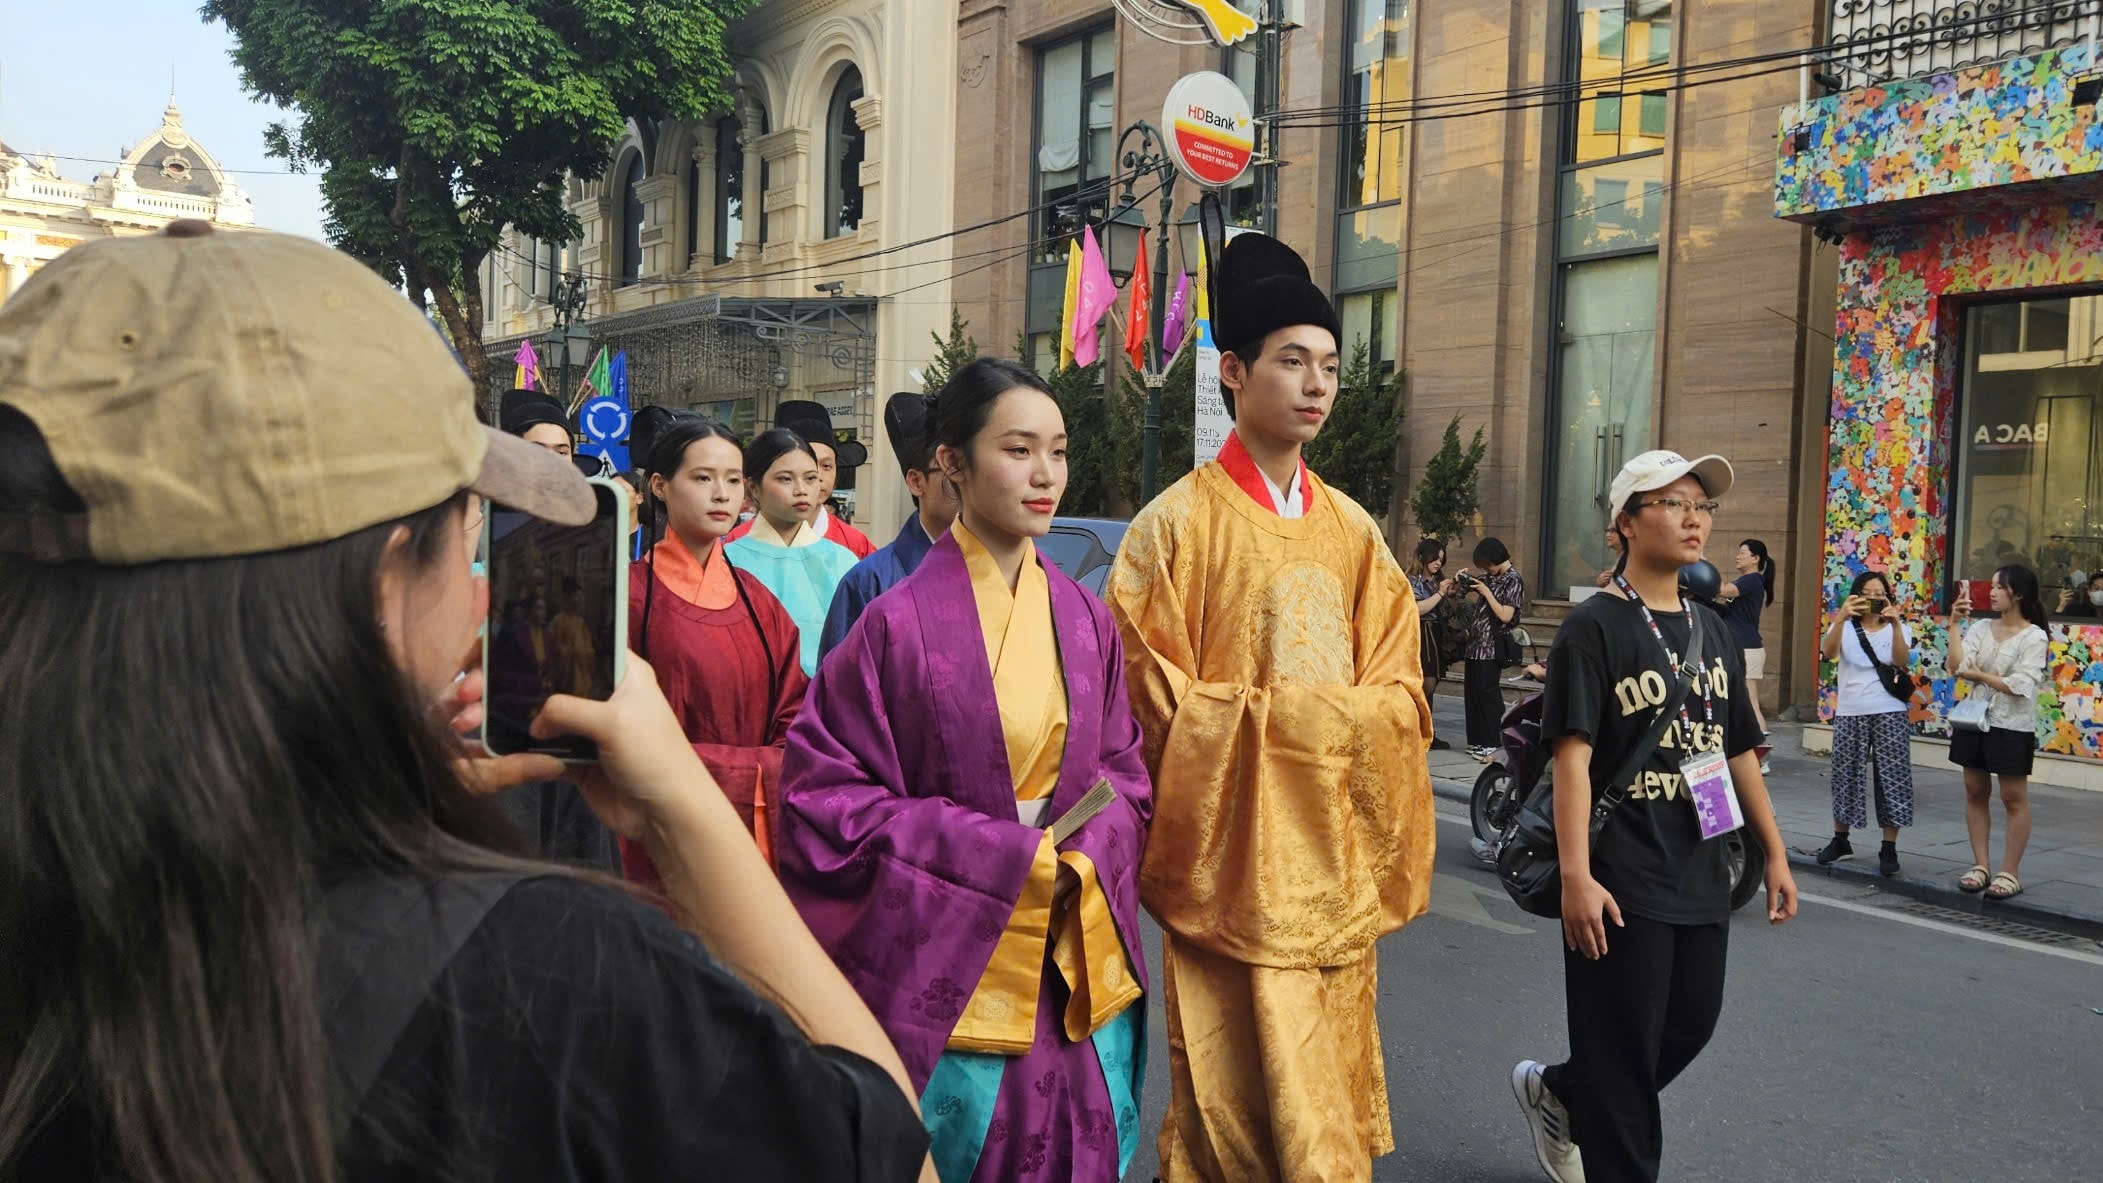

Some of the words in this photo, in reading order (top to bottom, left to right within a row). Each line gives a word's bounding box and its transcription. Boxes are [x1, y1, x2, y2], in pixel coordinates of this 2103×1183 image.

[1188, 104, 1235, 131] HDBank
[1193, 141, 1226, 157] COMMITTED
[1186, 148, 1202, 158] YOUR
[1202, 153, 1215, 163] BEST
[1215, 156, 1239, 170] RETURNS
[1196, 438, 1226, 448] 17.11.20
